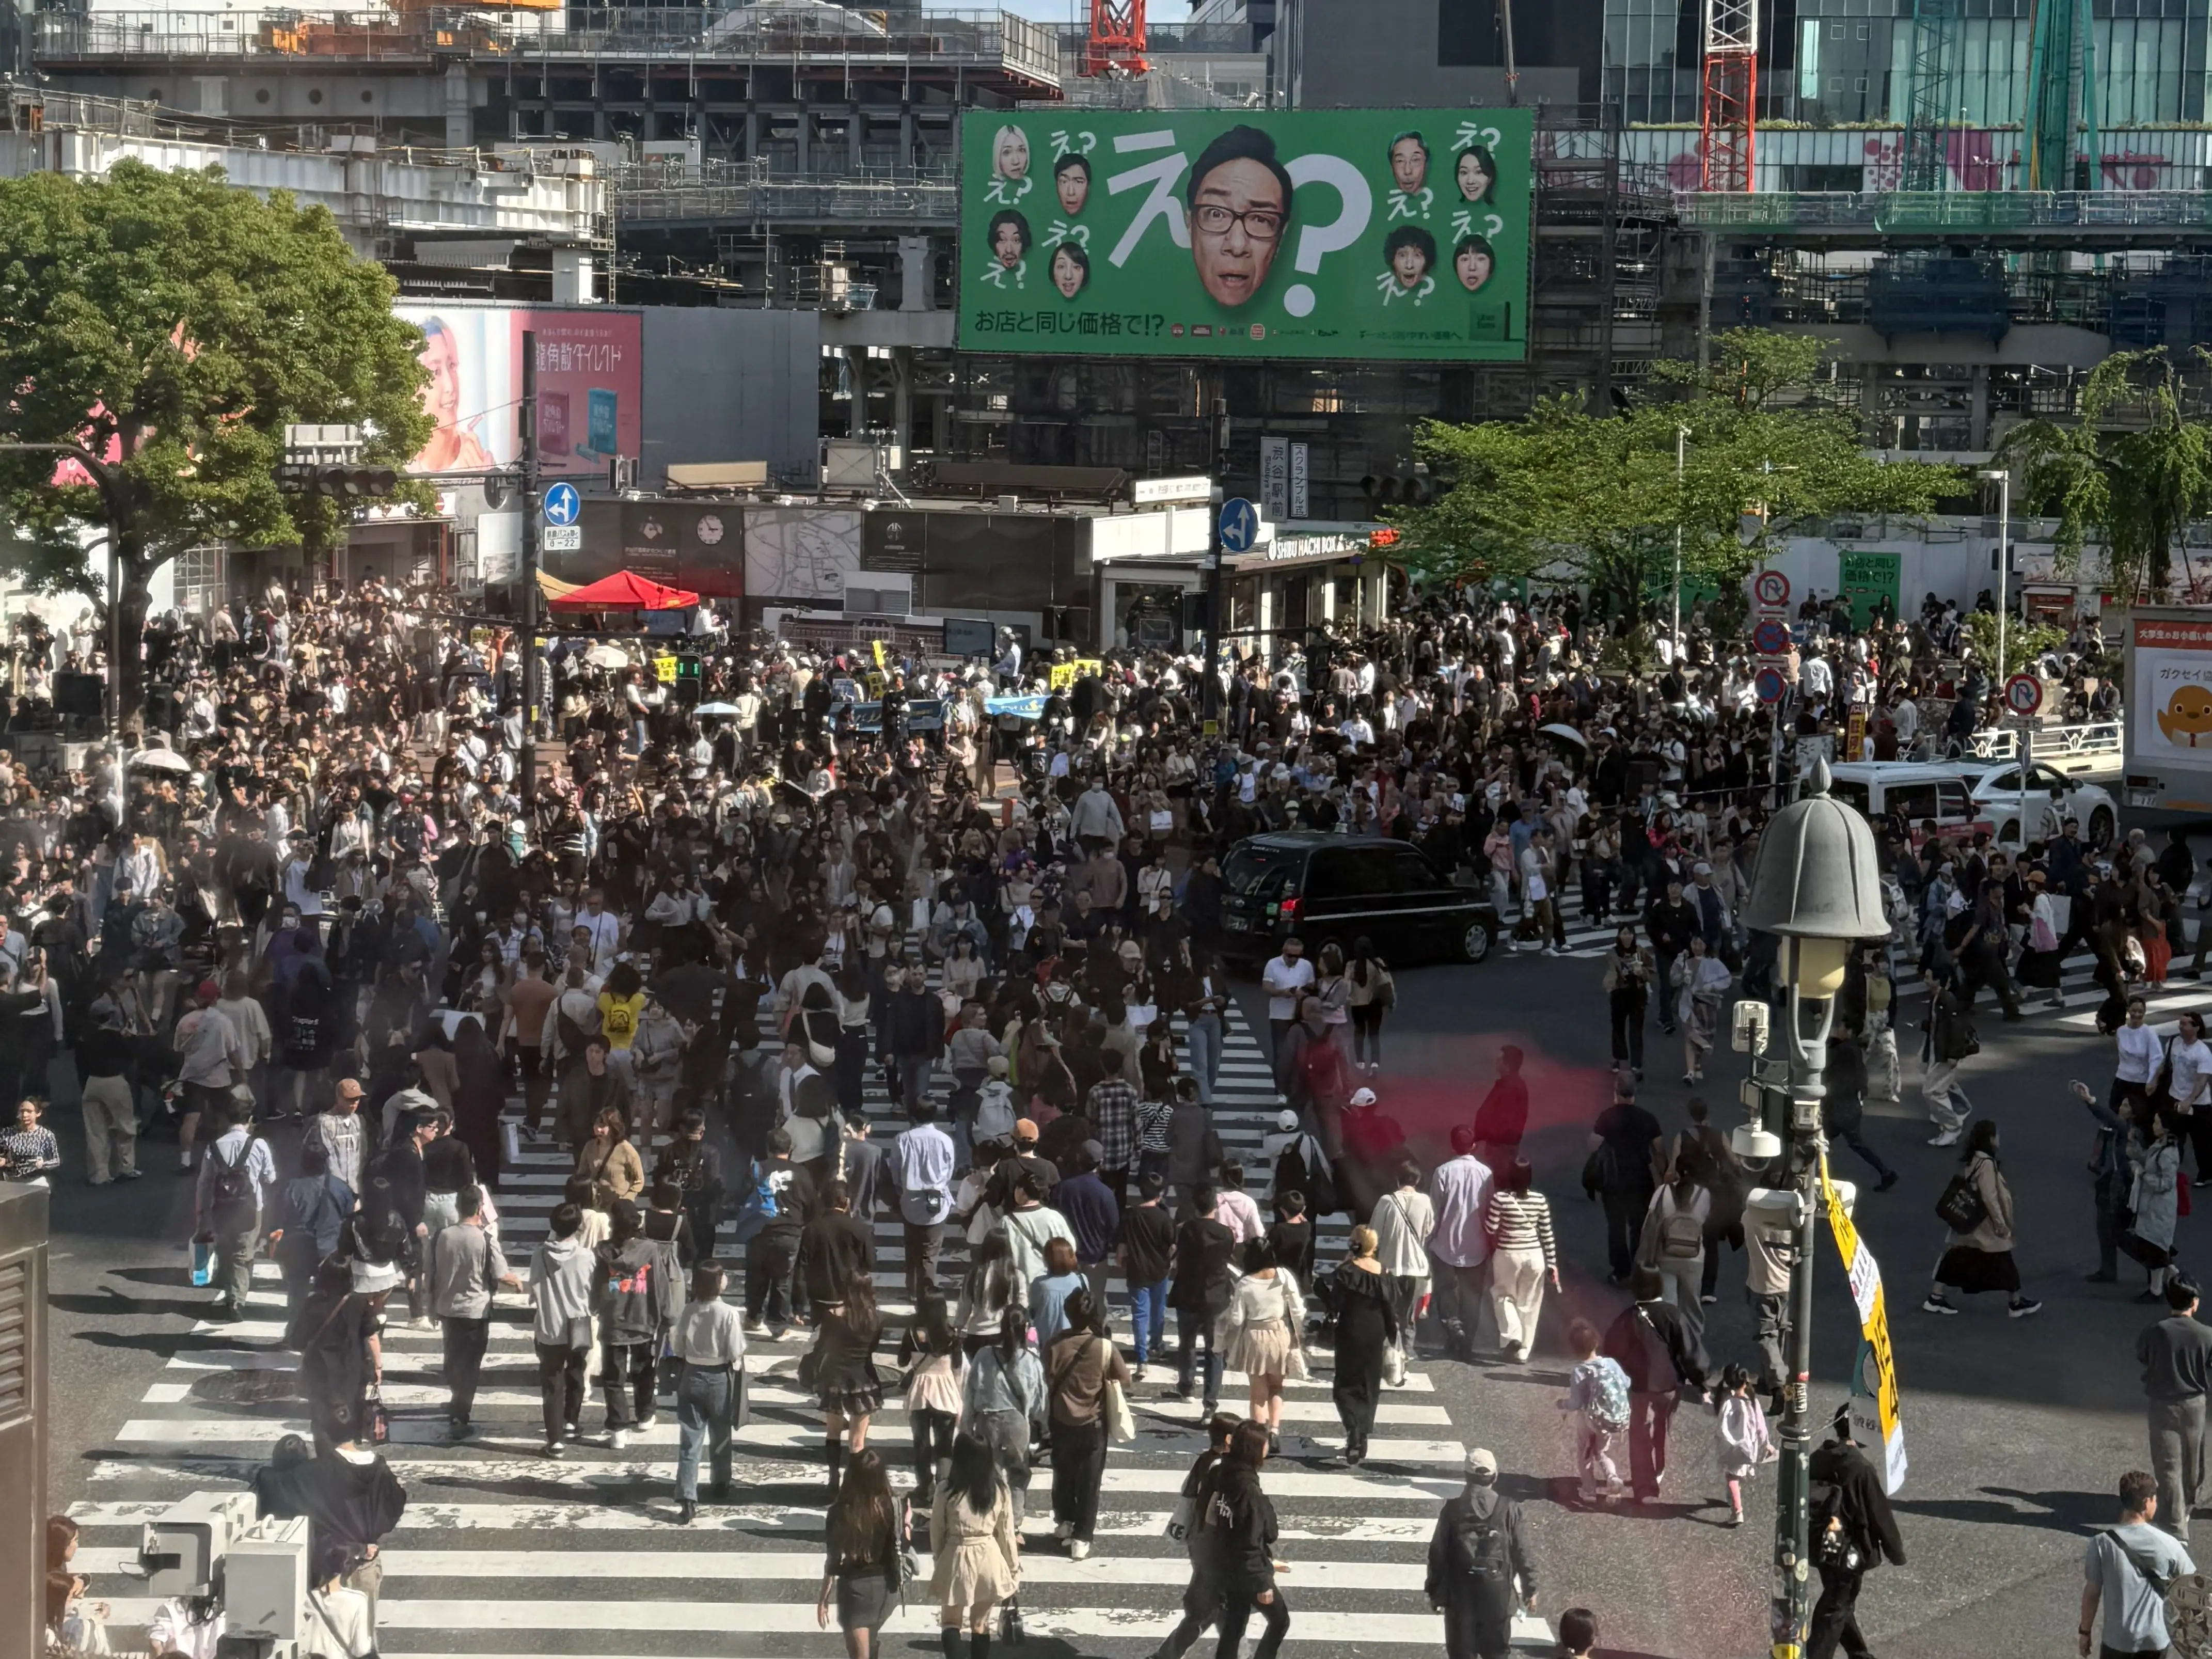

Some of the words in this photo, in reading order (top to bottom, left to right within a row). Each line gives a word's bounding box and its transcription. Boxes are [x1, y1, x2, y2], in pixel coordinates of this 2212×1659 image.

[1387, 187, 1434, 220] え?
[974, 310, 1165, 336] お店と同じ価格で!?
[1272, 446, 1284, 516] 渋谷駅前
[1321, 535, 1336, 554] BOX
